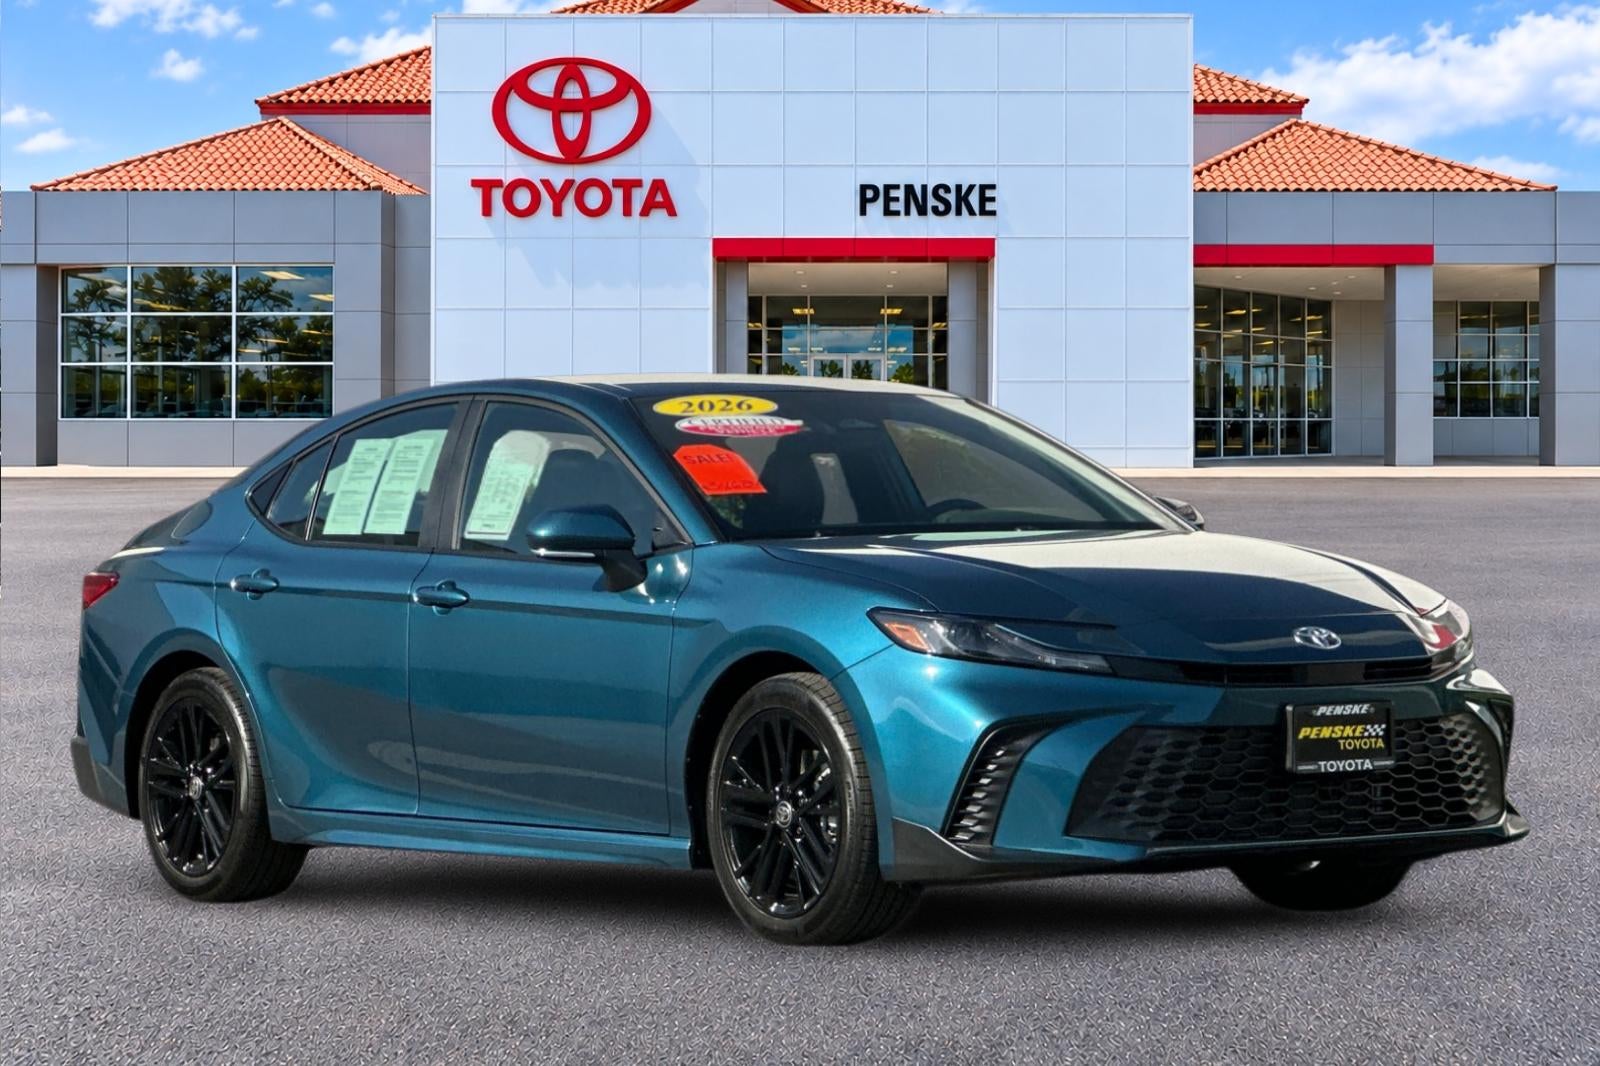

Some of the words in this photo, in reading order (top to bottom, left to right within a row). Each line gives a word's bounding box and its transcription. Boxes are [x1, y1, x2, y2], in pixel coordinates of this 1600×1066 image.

[470, 178, 678, 218] TOYOTA
[858, 183, 997, 216] PENSKE
[681, 399, 752, 413] 2026
[1316, 704, 1370, 716] PENSKE
[1298, 725, 1365, 739] PENSKE
[1338, 738, 1384, 750] TOYOTA
[1318, 759, 1373, 772] TOYOTA
